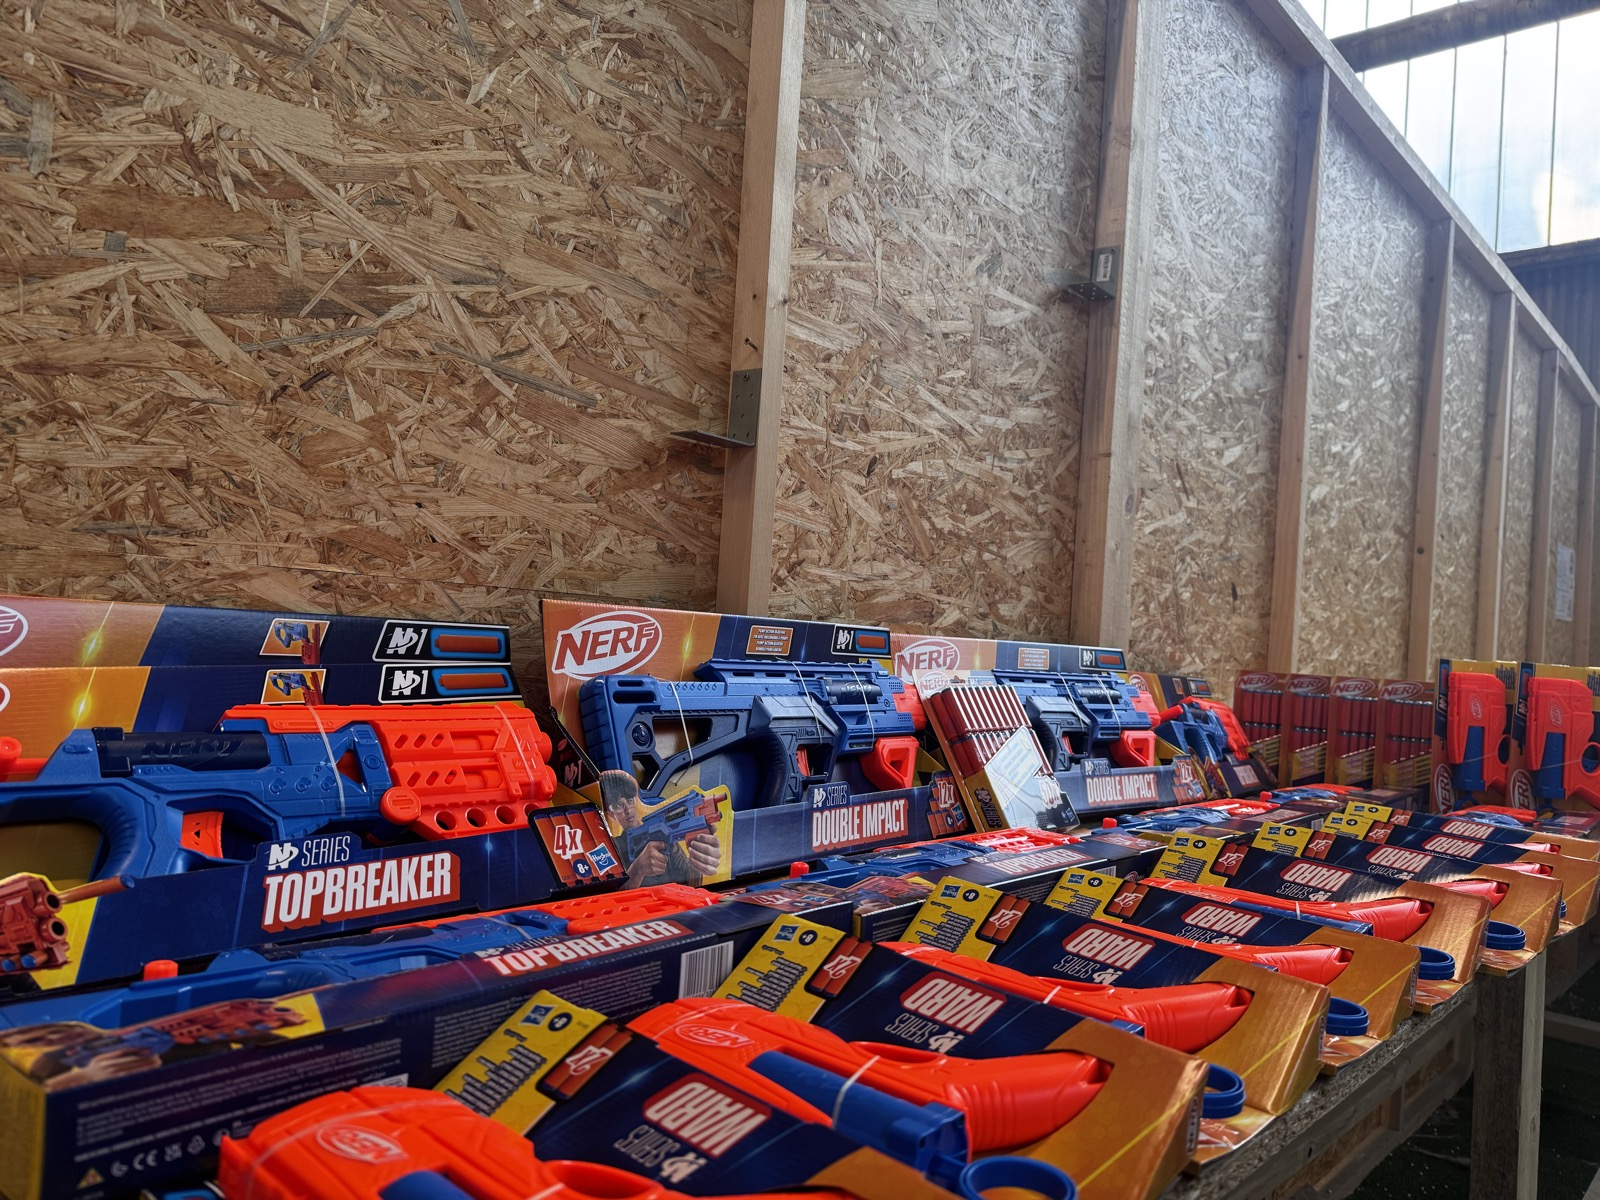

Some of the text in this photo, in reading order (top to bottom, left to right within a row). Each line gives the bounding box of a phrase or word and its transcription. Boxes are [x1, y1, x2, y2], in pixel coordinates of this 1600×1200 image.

[555, 621, 656, 671] NERF
[896, 645, 957, 679] NERF
[827, 785, 847, 807] SERIES
[1086, 773, 1156, 803] DOUBLE IMPACT
[812, 805, 860, 848] DOUBLE
[862, 799, 905, 838] IMPACT
[1443, 820, 1495, 840] WARD
[301, 835, 351, 867] SERIES
[985, 849, 1087, 875] TOPBREAKER
[1368, 847, 1434, 873] WARD
[1424, 836, 1484, 858] WARD
[577, 863, 590, 874] 8+
[1285, 862, 1354, 893] WARD
[264, 852, 452, 926] TOPBREAKER
[965, 891, 976, 900] 8+
[1276, 882, 1310, 899] SERIES
[1184, 904, 1262, 937] WARD
[484, 920, 682, 977] TOPBREAKER
[801, 932, 814, 943] 8+
[1064, 927, 1154, 970] WARD
[1052, 954, 1101, 979] SERIES
[902, 977, 1005, 1033] WARD
[553, 1015, 569, 1029] 8+
[885, 1012, 940, 1044] SERIES
[643, 1081, 768, 1158] WARD
[613, 1123, 681, 1168] SERIES
